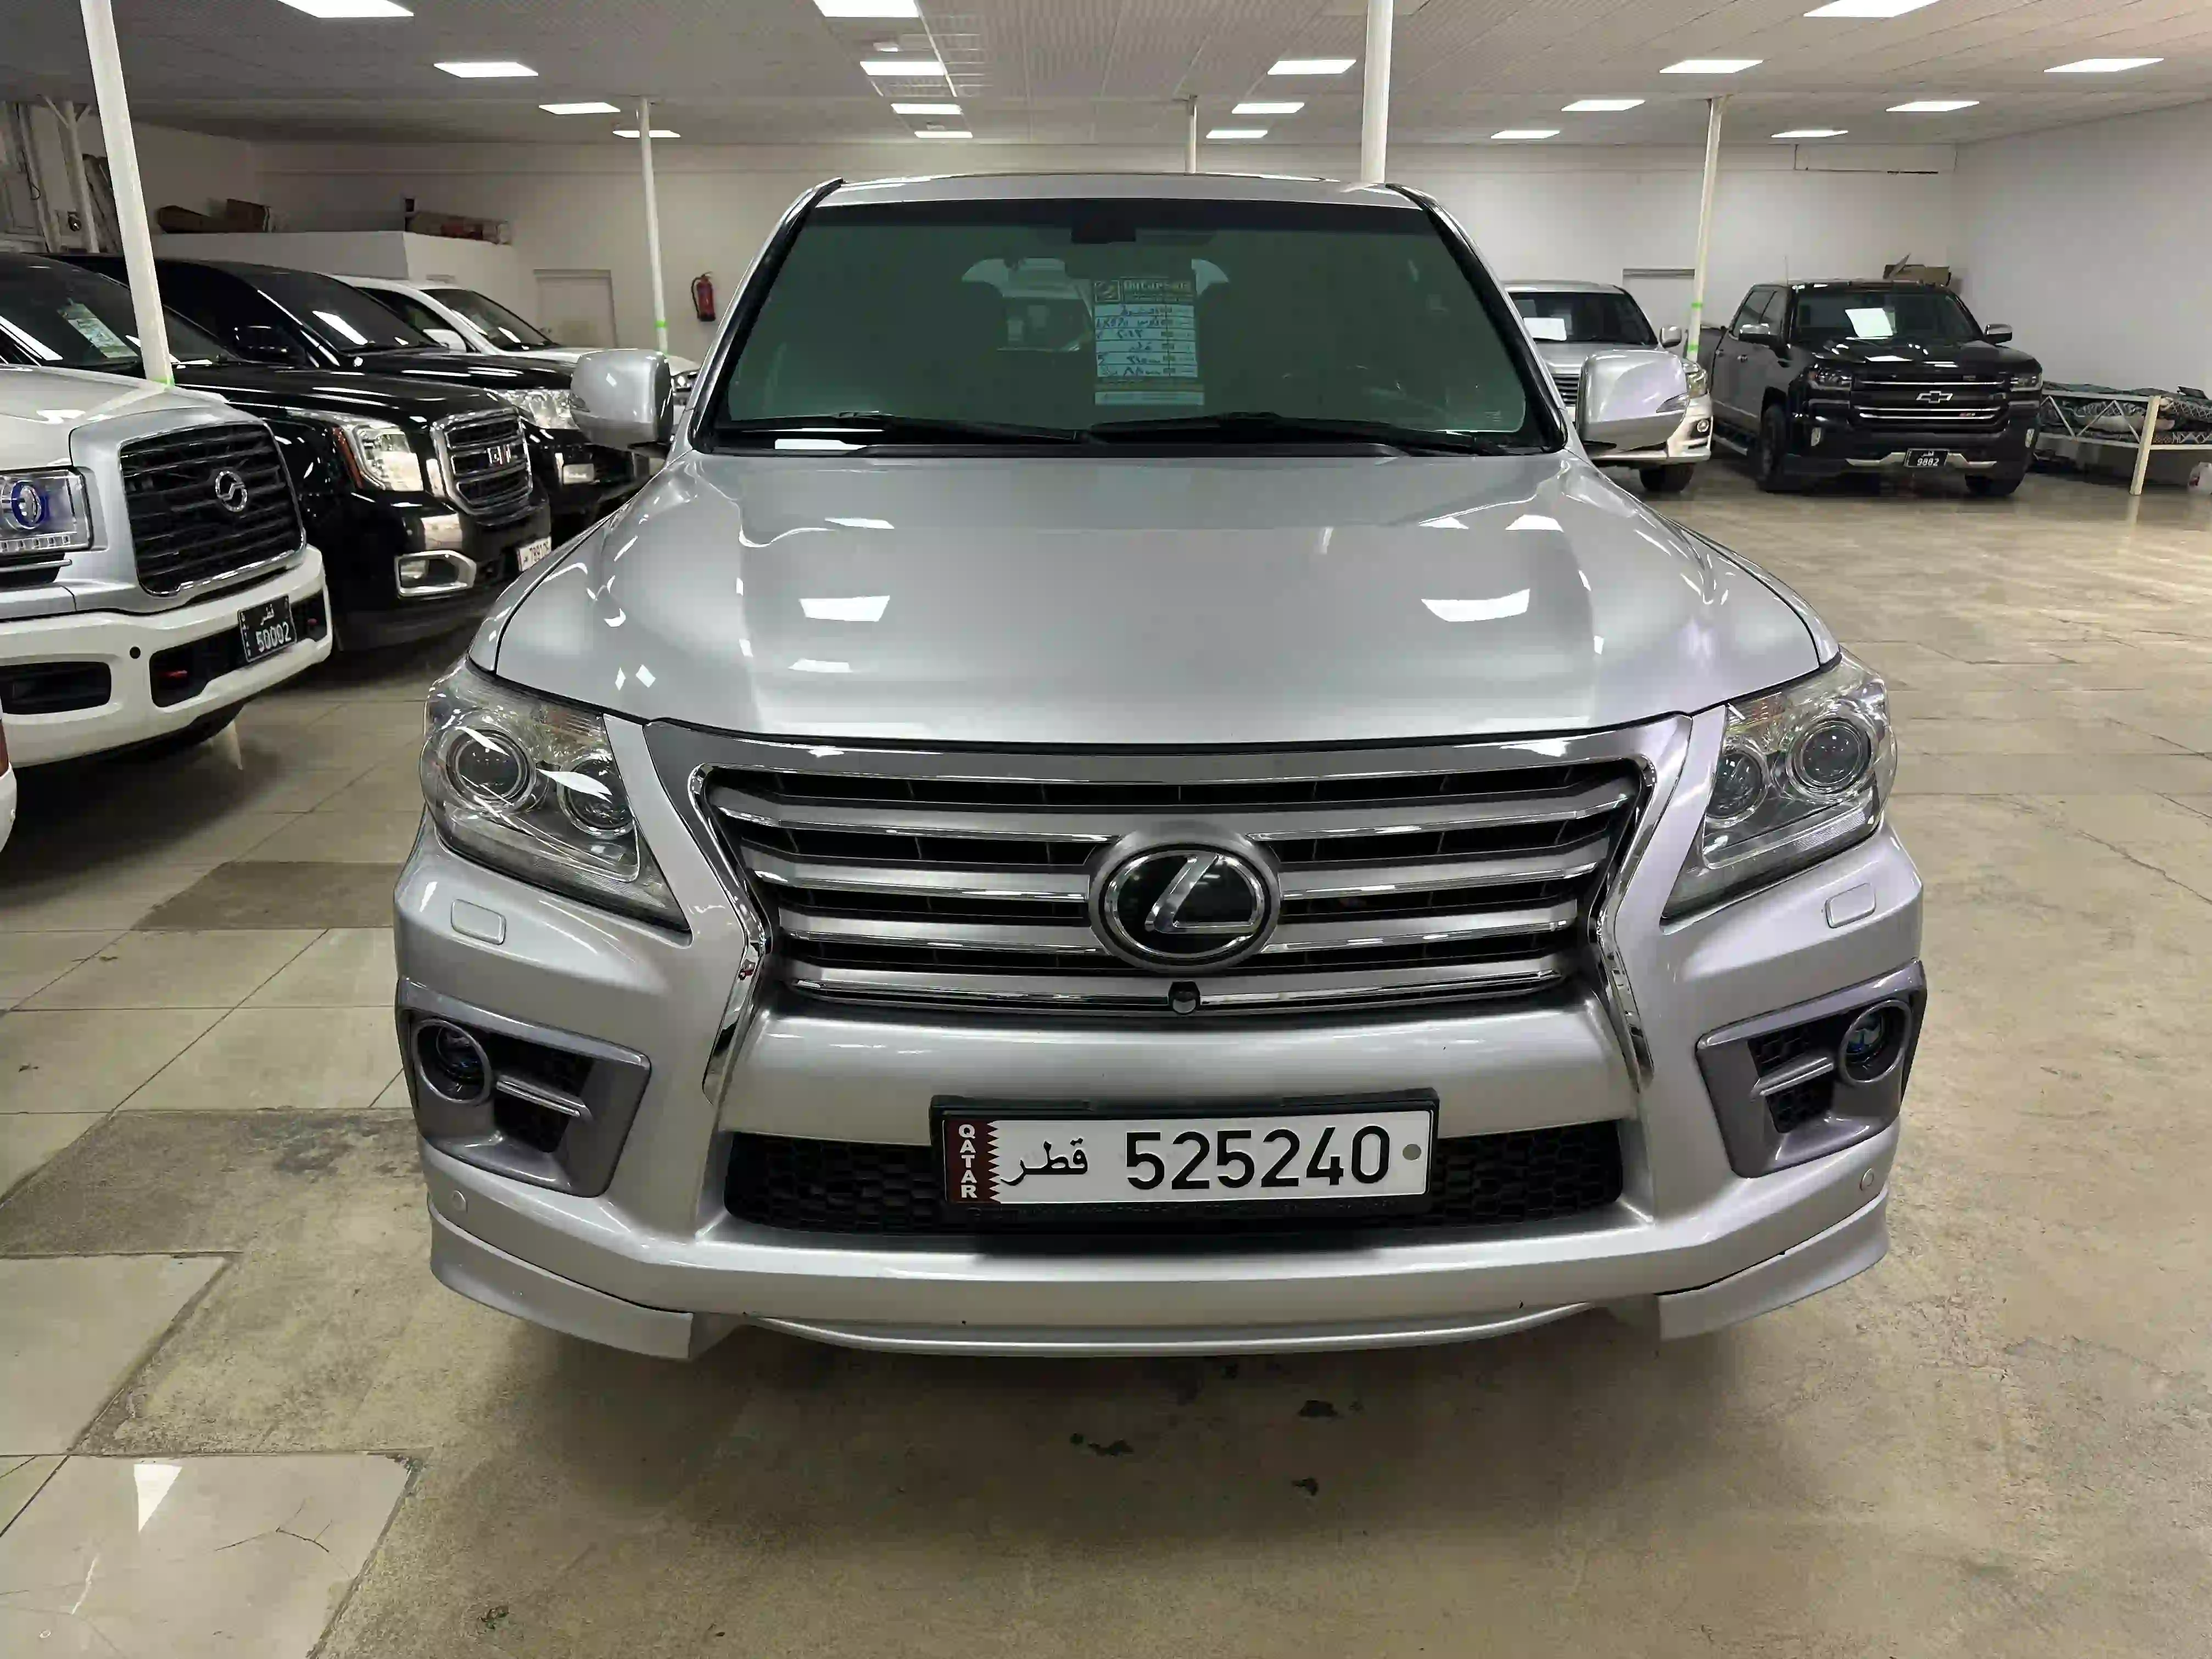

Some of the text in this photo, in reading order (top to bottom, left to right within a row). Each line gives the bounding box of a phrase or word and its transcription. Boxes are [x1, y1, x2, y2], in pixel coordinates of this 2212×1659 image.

[958, 1124, 977, 1198] QATAR
[1001, 1125, 1390, 1190] قطر 525240
